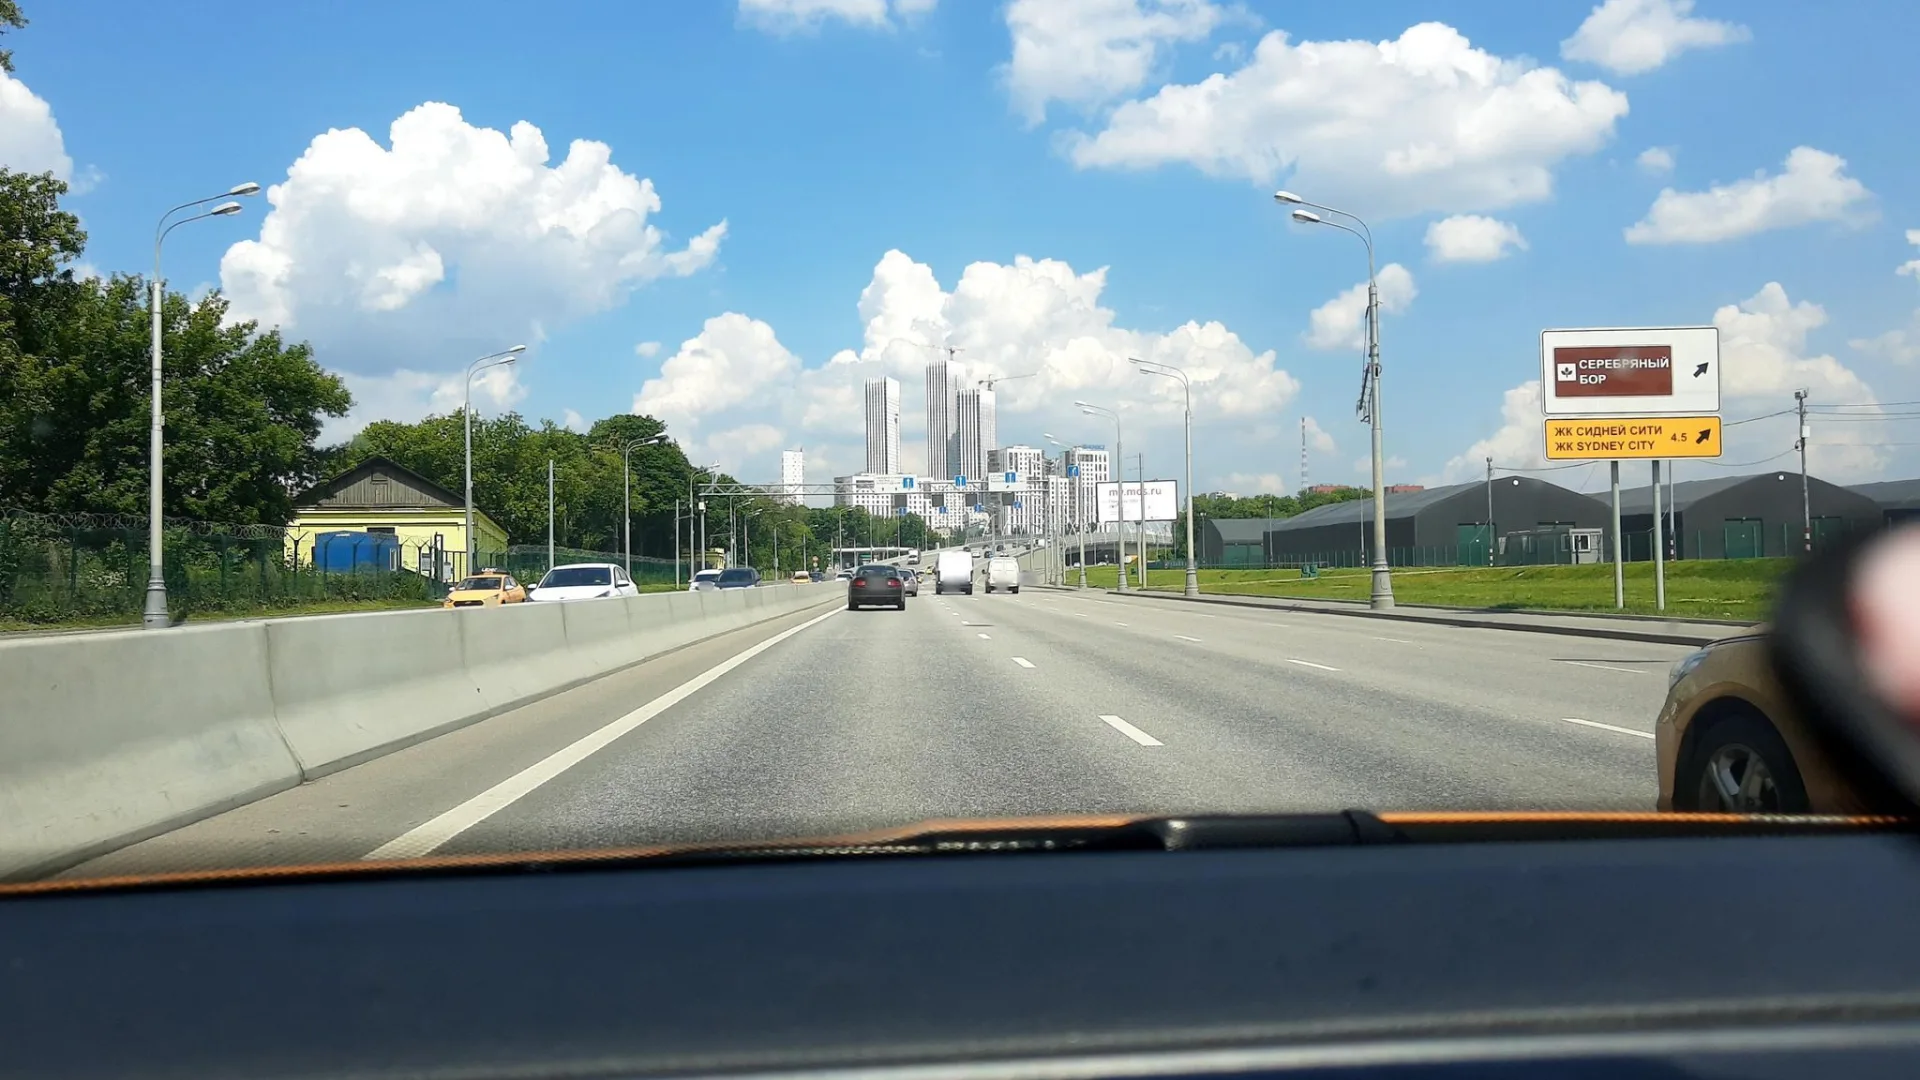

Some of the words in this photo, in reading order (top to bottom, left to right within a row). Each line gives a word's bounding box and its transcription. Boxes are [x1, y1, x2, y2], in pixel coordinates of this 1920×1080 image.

[1578, 357, 1669, 370] СЕРЕБРЯНЫЙ
[1579, 374, 1606, 385] БОР
[1555, 427, 1572, 436] ЖК
[1576, 425, 1626, 437] СИДНЕЙ
[1629, 426, 1662, 435] СИТИ
[1671, 433, 1687, 442] 4.5
[1555, 442, 1572, 451] ЖК
[1577, 440, 1625, 451] SYDNEY
[1628, 441, 1655, 450] CITY
